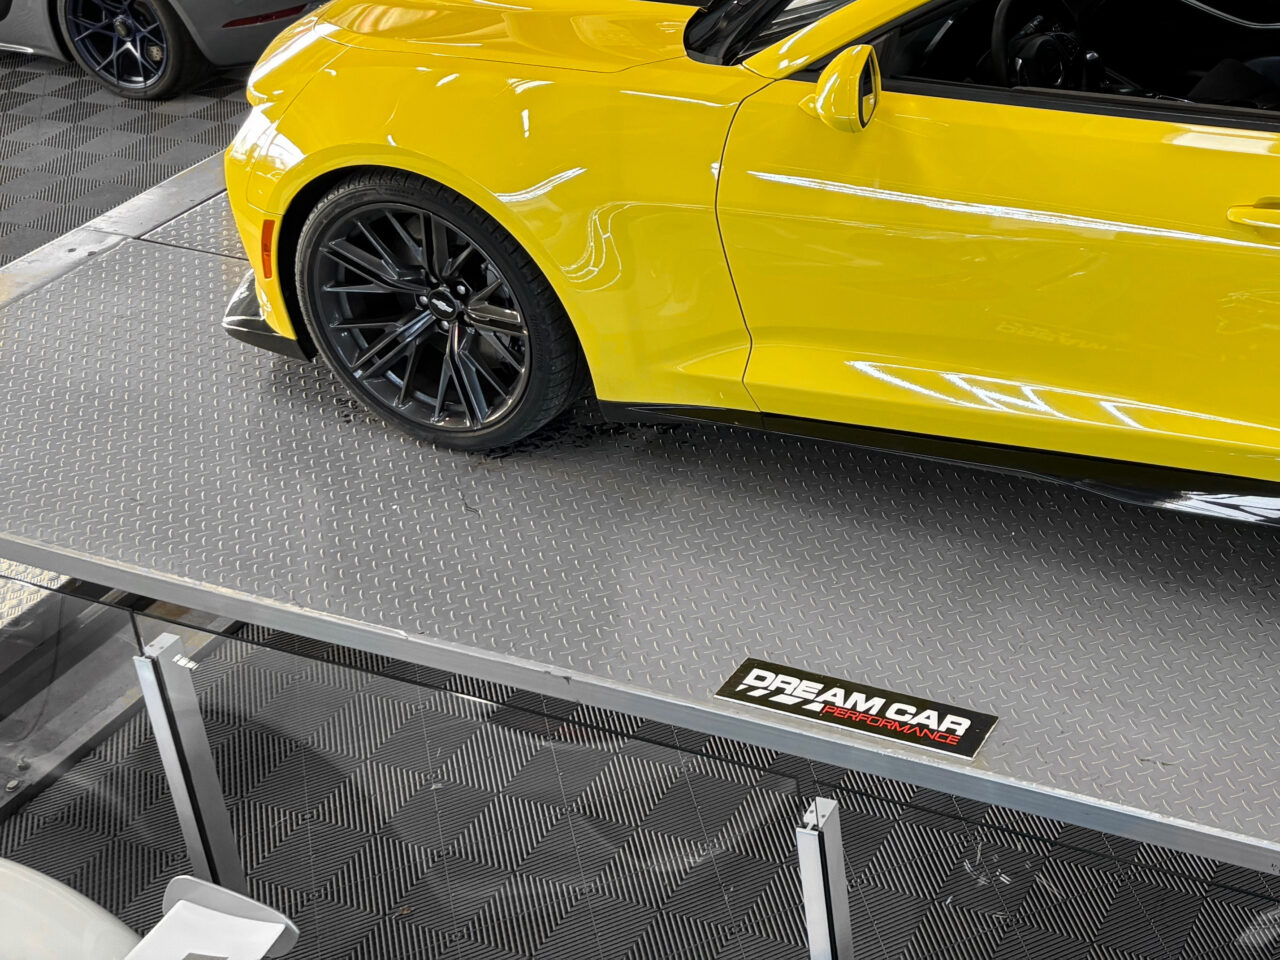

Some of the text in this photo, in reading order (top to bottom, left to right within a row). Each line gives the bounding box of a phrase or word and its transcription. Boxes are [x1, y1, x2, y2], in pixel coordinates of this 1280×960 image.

[743, 668, 972, 736] DREAM CAR
[822, 705, 961, 745] PERFORMANCE
